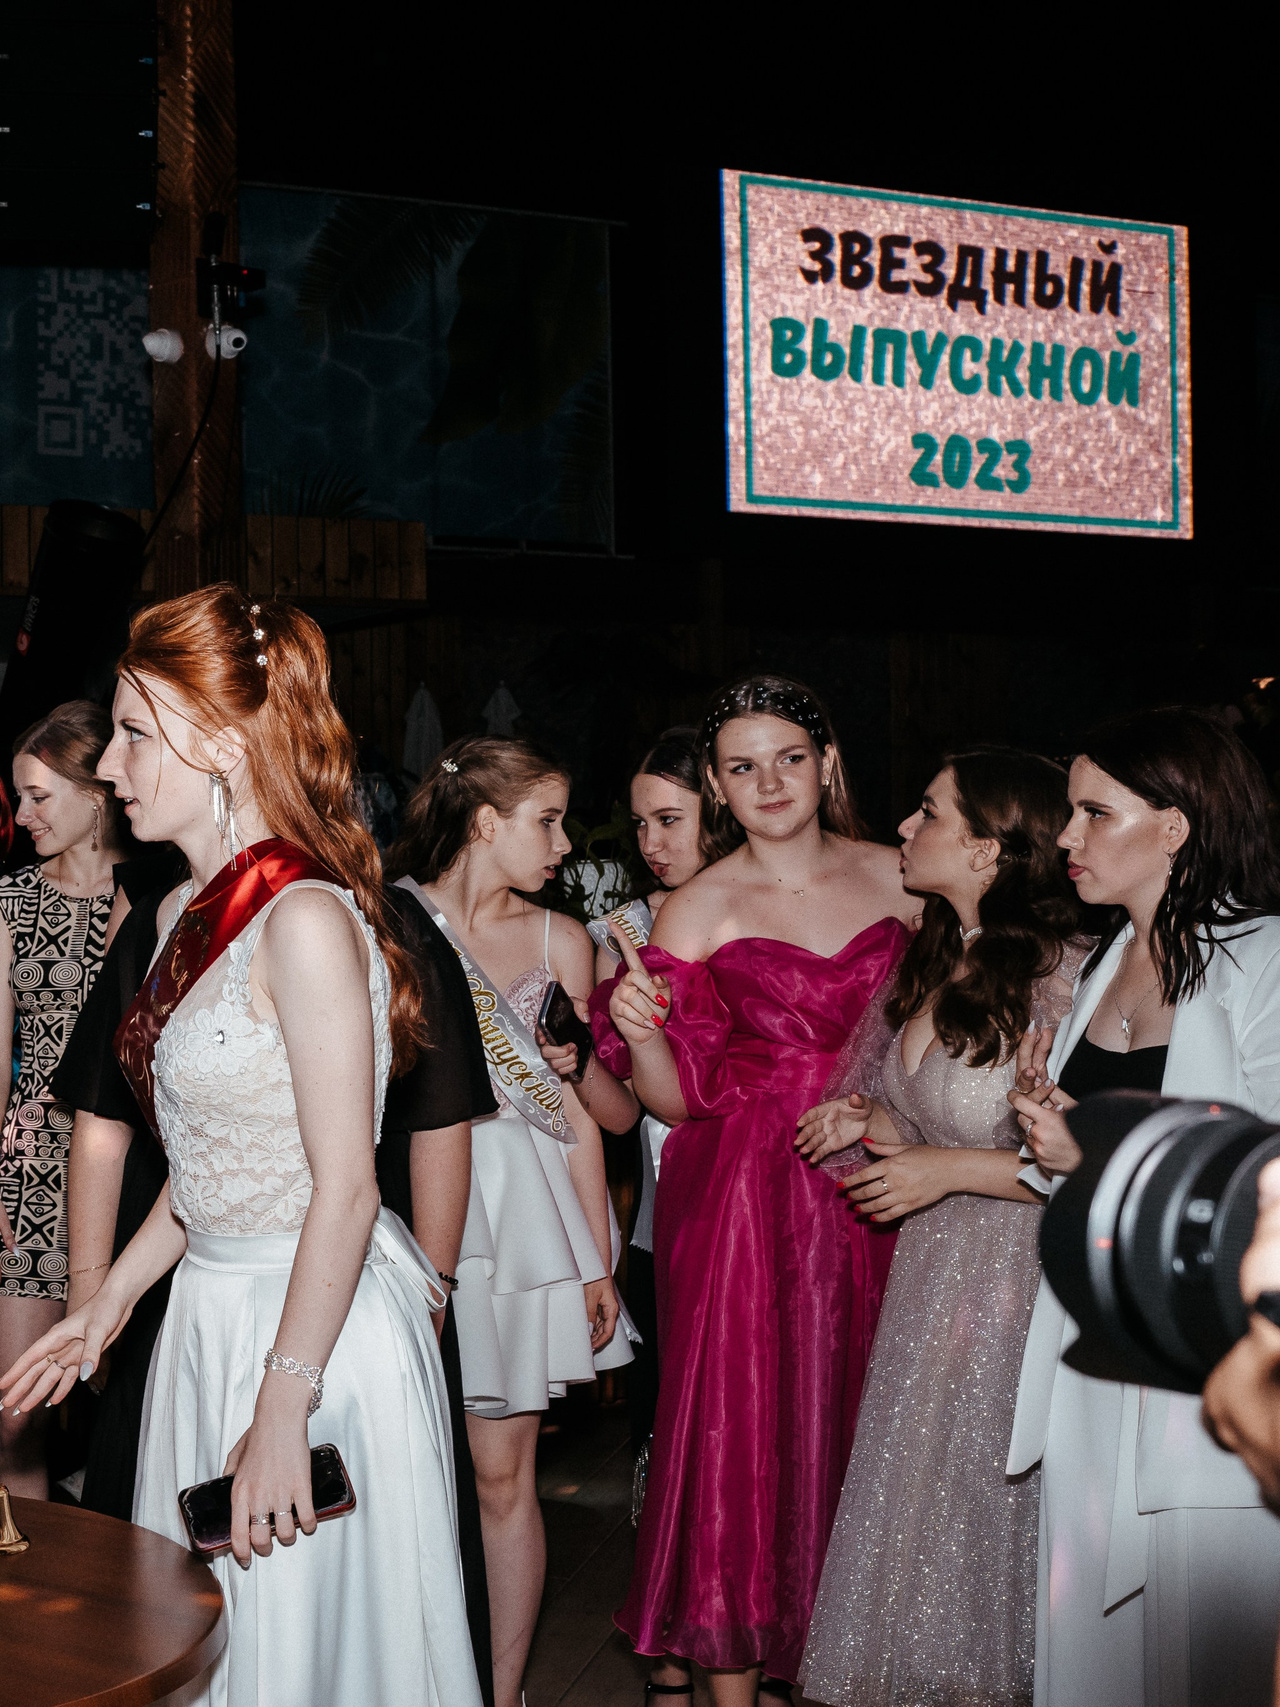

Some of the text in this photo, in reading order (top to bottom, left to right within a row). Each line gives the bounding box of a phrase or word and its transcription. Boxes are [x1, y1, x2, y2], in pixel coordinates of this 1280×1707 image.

[799, 226, 1122, 317] ЗВЕЗДНЫЙ
[769, 317, 1141, 408] ВЫПУСКНОЙ
[908, 433, 1032, 494] 2023
